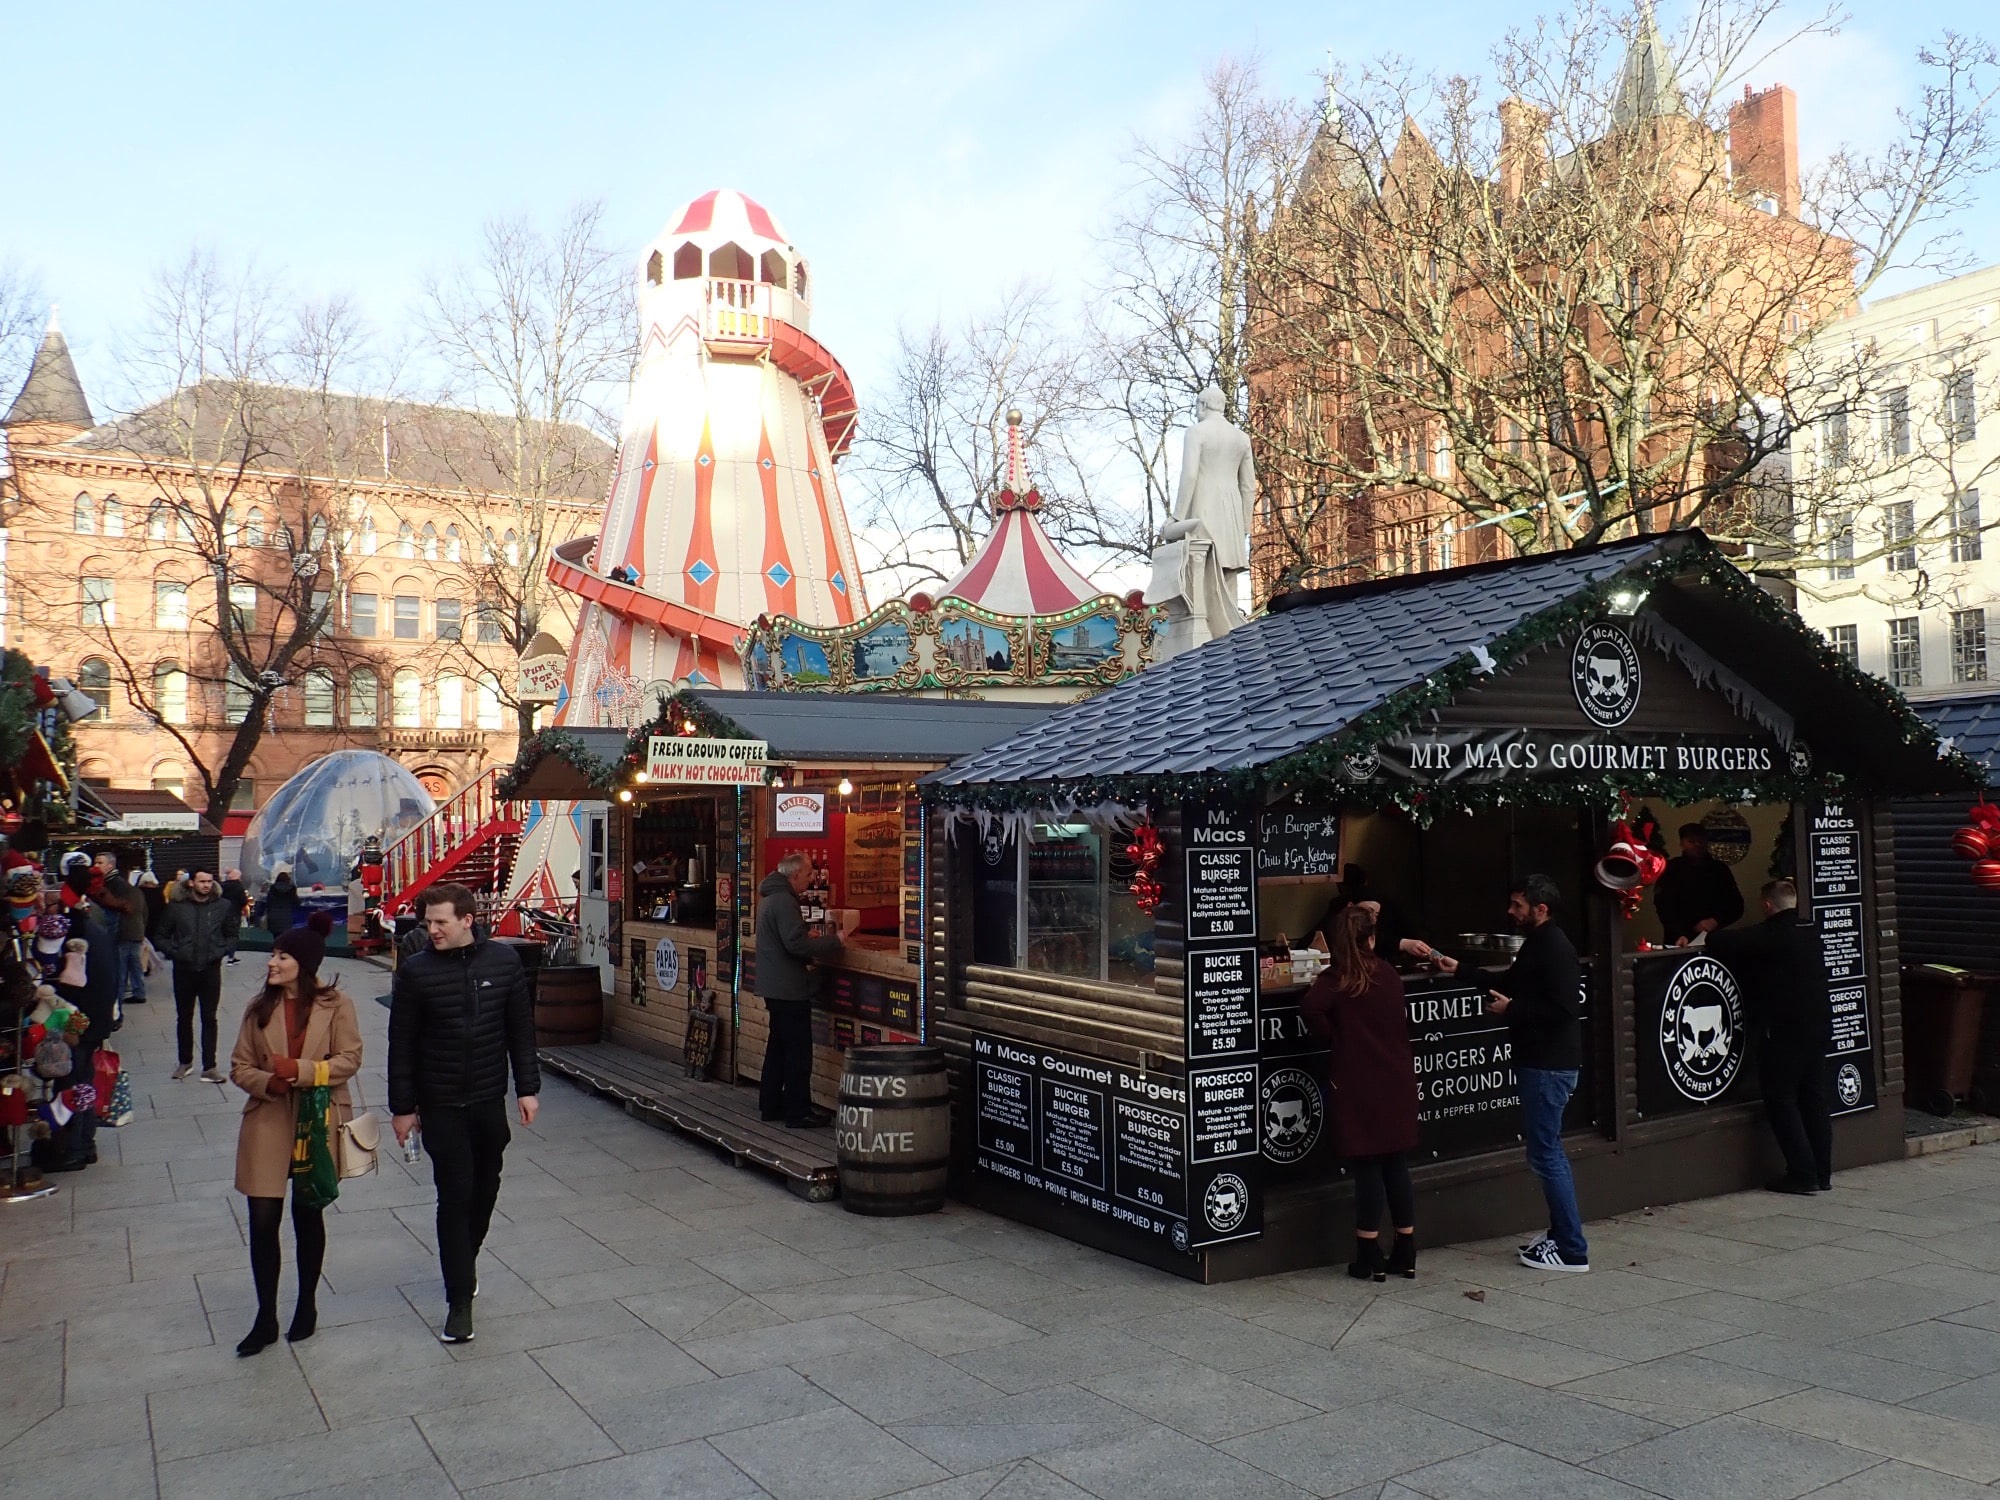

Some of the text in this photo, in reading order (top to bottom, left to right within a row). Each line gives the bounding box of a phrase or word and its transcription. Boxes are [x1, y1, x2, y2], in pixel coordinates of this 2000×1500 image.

[1577, 628, 1637, 682] K & G McATAMNEY
[522, 664, 546, 678] Fun
[531, 672, 552, 686] For
[544, 678, 559, 691] All
[1584, 696, 1632, 719] BUTCHERY & DELI
[653, 742, 762, 760] FRESH GROUND COFFEE
[1410, 743, 1451, 769] MR
[1465, 743, 1537, 769] MACS
[1550, 744, 1668, 770] GOURMET
[1677, 747, 1771, 770] BURGERS
[652, 764, 761, 782] MILKY HOT CHOCOLATE
[780, 798, 818, 811] BAILEYS
[1825, 805, 1843, 816] Mr
[1285, 814, 1322, 840] Burger
[1814, 818, 1854, 829] Macs
[1193, 828, 1246, 842] Macs
[1820, 836, 1851, 845] CLASSIC
[1199, 854, 1241, 865] CLASSIC
[1308, 846, 1336, 865] Ketchup
[1821, 847, 1850, 856] BURGER
[1201, 869, 1240, 880] BURGER
[1828, 884, 1846, 892] £5.00
[1825, 908, 1852, 918] BUCKIE
[1211, 920, 1234, 932] £5.00
[1824, 919, 1853, 929] BURGER
[657, 950, 676, 970] PAPAS
[1205, 955, 1241, 968] BUCKIE
[1203, 970, 1243, 984] BURGER
[1832, 966, 1850, 976] £5.50
[1221, 987, 1251, 995] Cheddar
[1830, 990, 1862, 1002] OSECCO
[1220, 1003, 1240, 1011] Cured
[1405, 995, 1486, 1024] URMET
[1663, 963, 1743, 1042] K & G McATAMNEY
[1832, 1002, 1857, 1013] URGER
[1199, 1013, 1224, 1021] Streaky
[1202, 1020, 1227, 1029] Special
[1230, 1018, 1252, 1026] Buckie
[1212, 1037, 1236, 1050] £5.50
[1837, 1039, 1855, 1050] £5.00
[1414, 1043, 1512, 1074] BURGERS AR
[975, 1039, 1186, 1103] Mr Macs Gourmet Burgers
[986, 1069, 1021, 1086] CLASSIC
[1673, 1052, 1738, 1092] BUTCHERY & DELI
[840, 1072, 907, 1097] AILEY'S
[1195, 1071, 1253, 1088] PROSECCO
[1432, 1071, 1503, 1098] GROUND
[988, 1082, 1020, 1099] BURGER
[1055, 1087, 1088, 1105] BUCKIE
[1204, 1088, 1244, 1102] BURGER
[1262, 1072, 1320, 1117] G McATAMNEY
[840, 1104, 873, 1128] HOT
[1053, 1100, 1090, 1119] BURGER
[1198, 1104, 1254, 1117] Mature Cheddar
[1417, 1095, 1520, 1122] ALT & PEPPER TO CREATE
[1118, 1104, 1180, 1130] PROSECCO
[1205, 1115, 1231, 1124] Cheese
[1128, 1121, 1170, 1142] BURGER
[1196, 1128, 1252, 1141] Strawberry Relish
[1207, 1123, 1238, 1131] Prosecco
[836, 1128, 914, 1153] COLATE
[995, 1138, 1015, 1153] £5.00
[1120, 1133, 1181, 1156] Mature Cheddar
[1214, 1140, 1237, 1153] £5.00
[1262, 1138, 1294, 1158] BUTCHERY
[1128, 1143, 1173, 1162] Cheese with
[1130, 1150, 1164, 1166] Prosecco
[1061, 1161, 1083, 1177] £5.50
[1120, 1155, 1181, 1180] Strawberry Relish
[978, 1157, 1165, 1235] ALL BURGERS 100% PRIME IRISH BEEF SUPPLIED BY
[1138, 1187, 1163, 1205] £5.00
[1218, 1176, 1246, 1204] McATAMNEY
